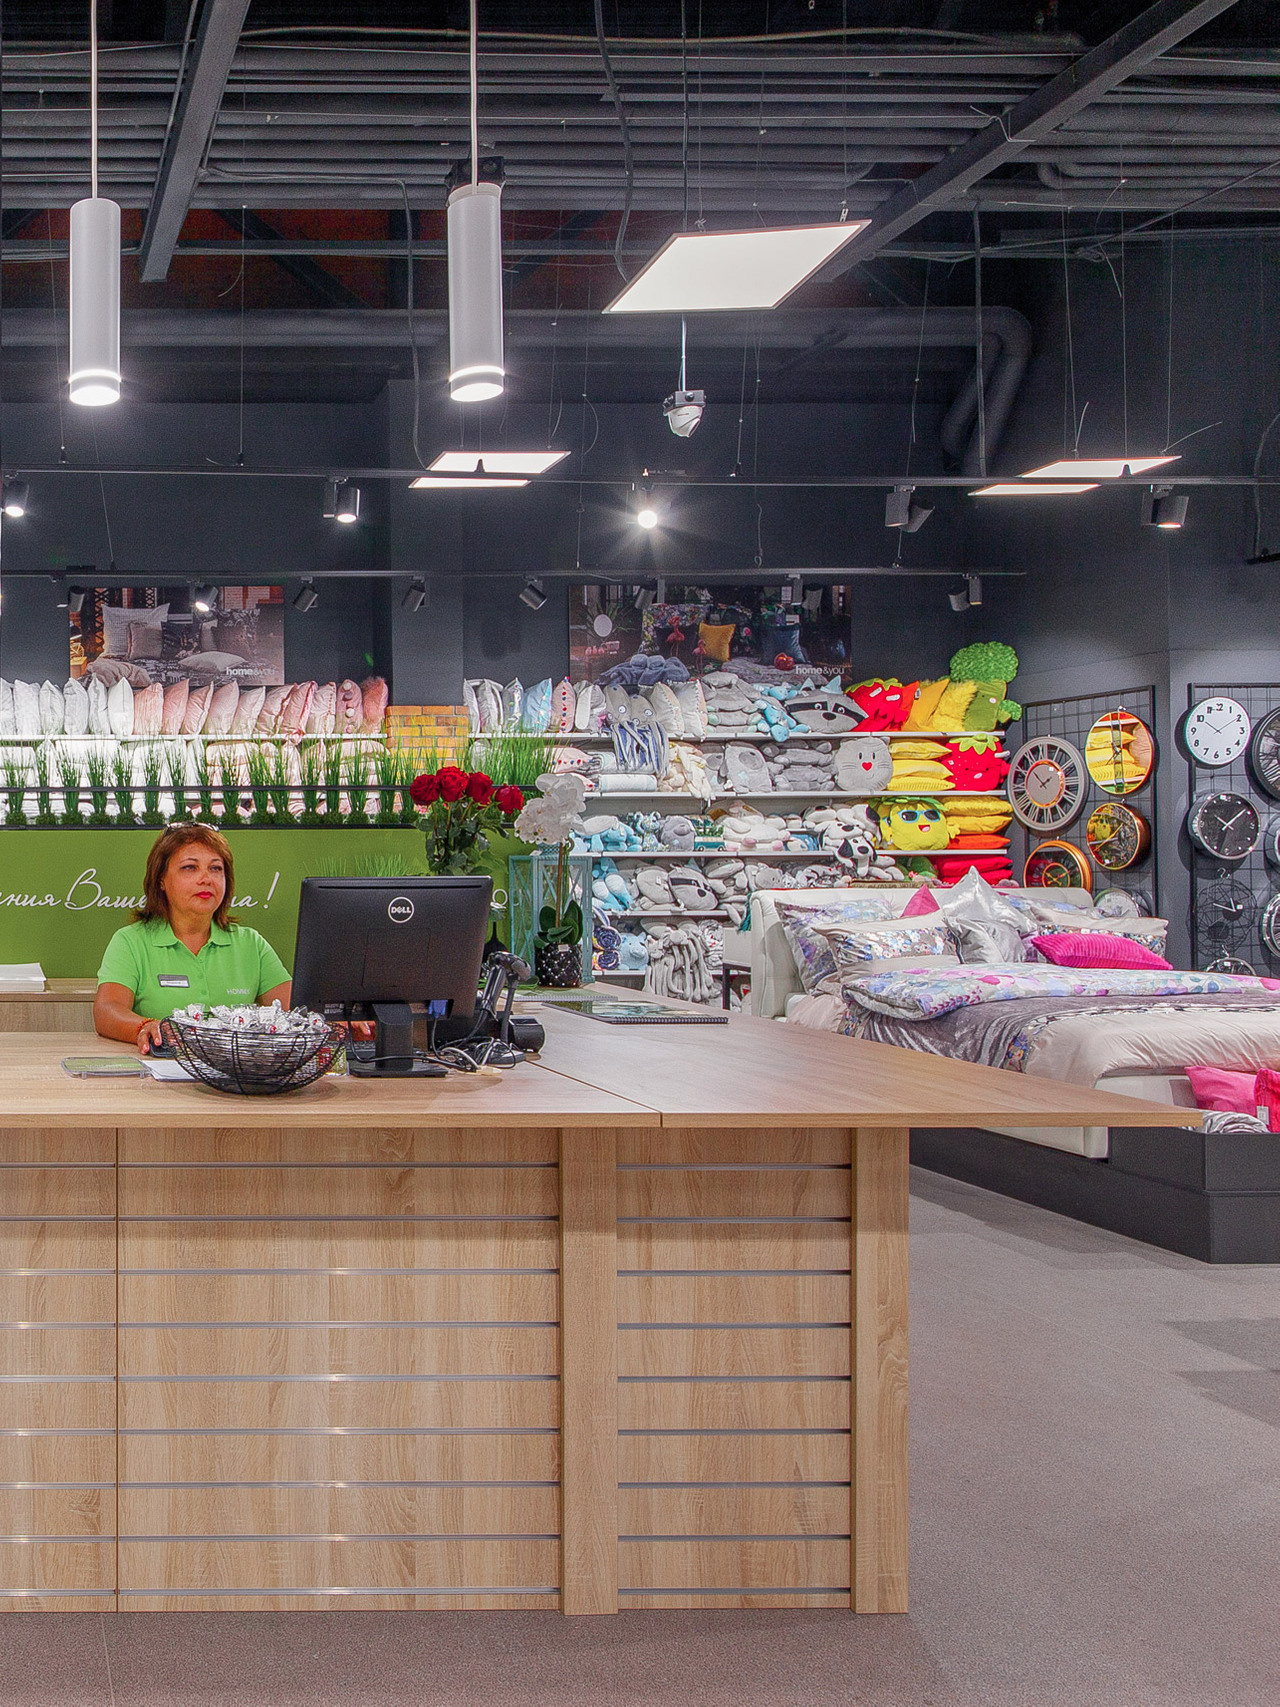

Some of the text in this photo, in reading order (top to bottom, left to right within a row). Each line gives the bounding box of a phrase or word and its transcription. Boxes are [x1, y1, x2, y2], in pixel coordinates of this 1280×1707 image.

[795, 665, 845, 677] home&you
[1236, 714, 1242, 722] 2
[1190, 727, 1197, 735] 9
[1240, 727, 1246, 735] 3
[1193, 739, 1200, 747] 8
[1234, 739, 1241, 747] 4
[1203, 748, 1210, 756] 7
[1213, 751, 1220, 759] 6
[1225, 748, 1232, 756] 5
[64, 867, 148, 911] Ваше
[390, 906, 412, 914] DELL
